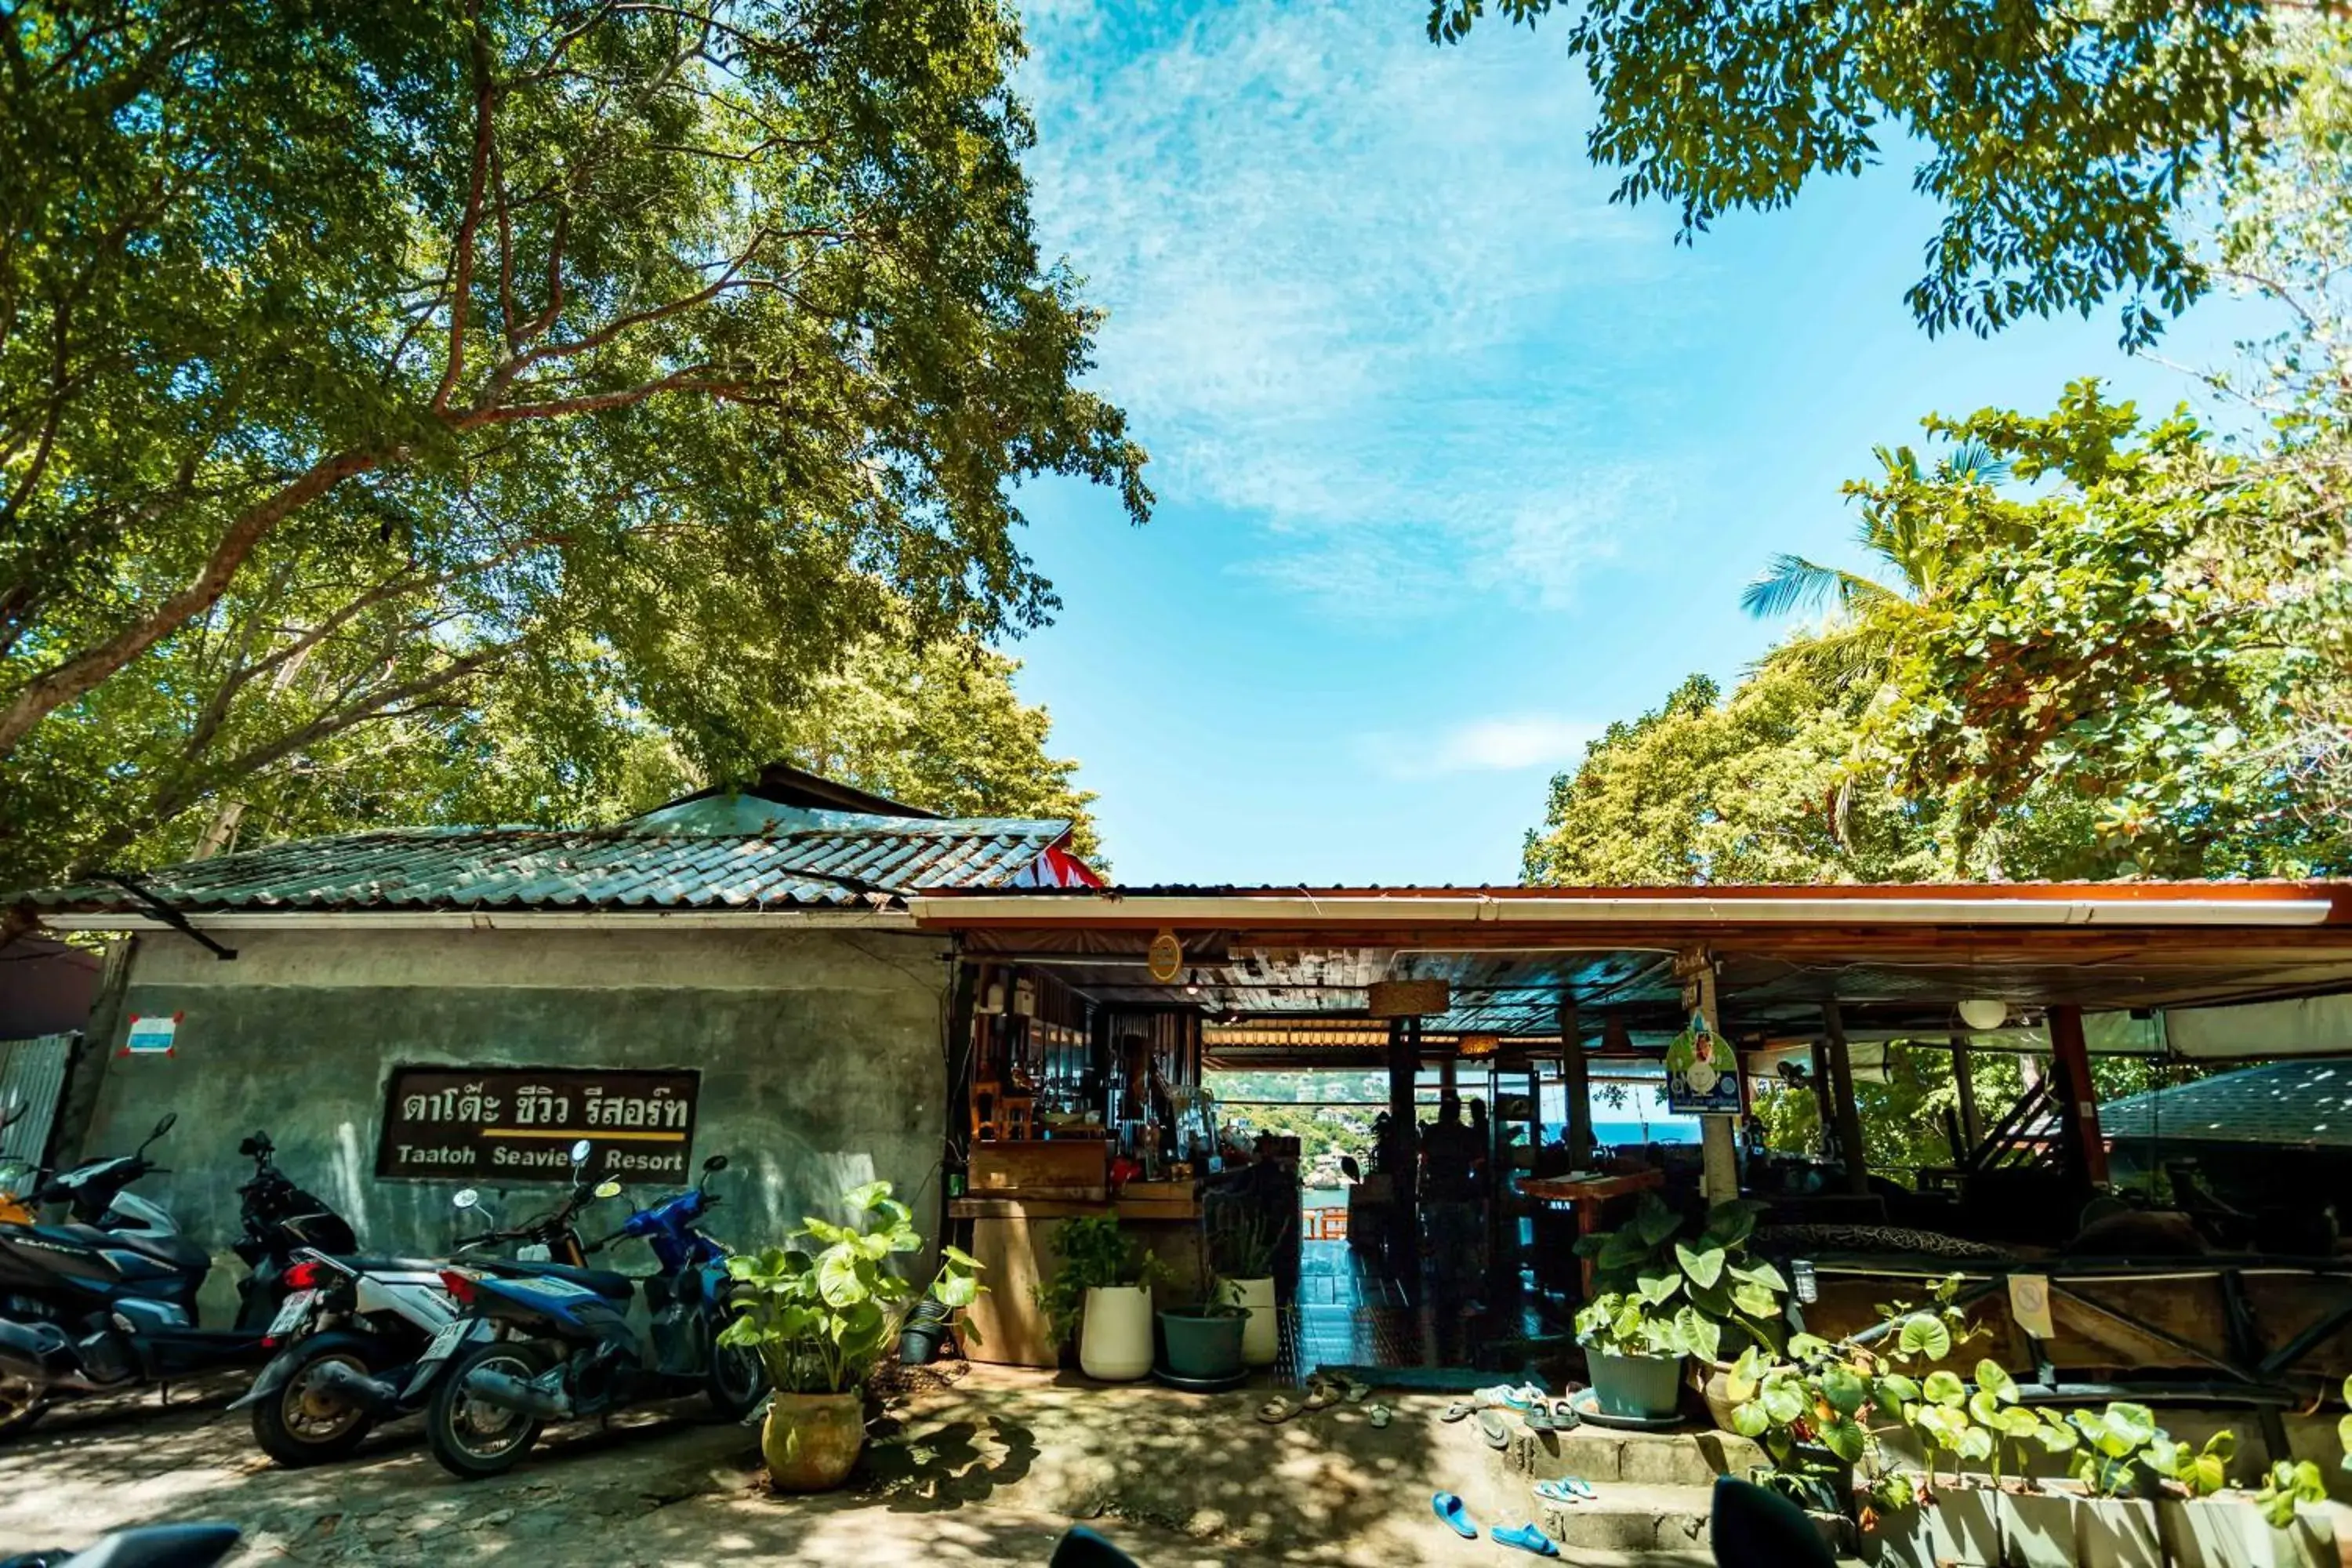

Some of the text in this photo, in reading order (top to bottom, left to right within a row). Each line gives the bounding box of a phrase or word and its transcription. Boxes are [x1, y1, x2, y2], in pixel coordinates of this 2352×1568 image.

[583, 1087, 688, 1127] รีสอร์ท
[397, 1145, 476, 1164] Taatoh
[605, 1149, 683, 1171] Resort
